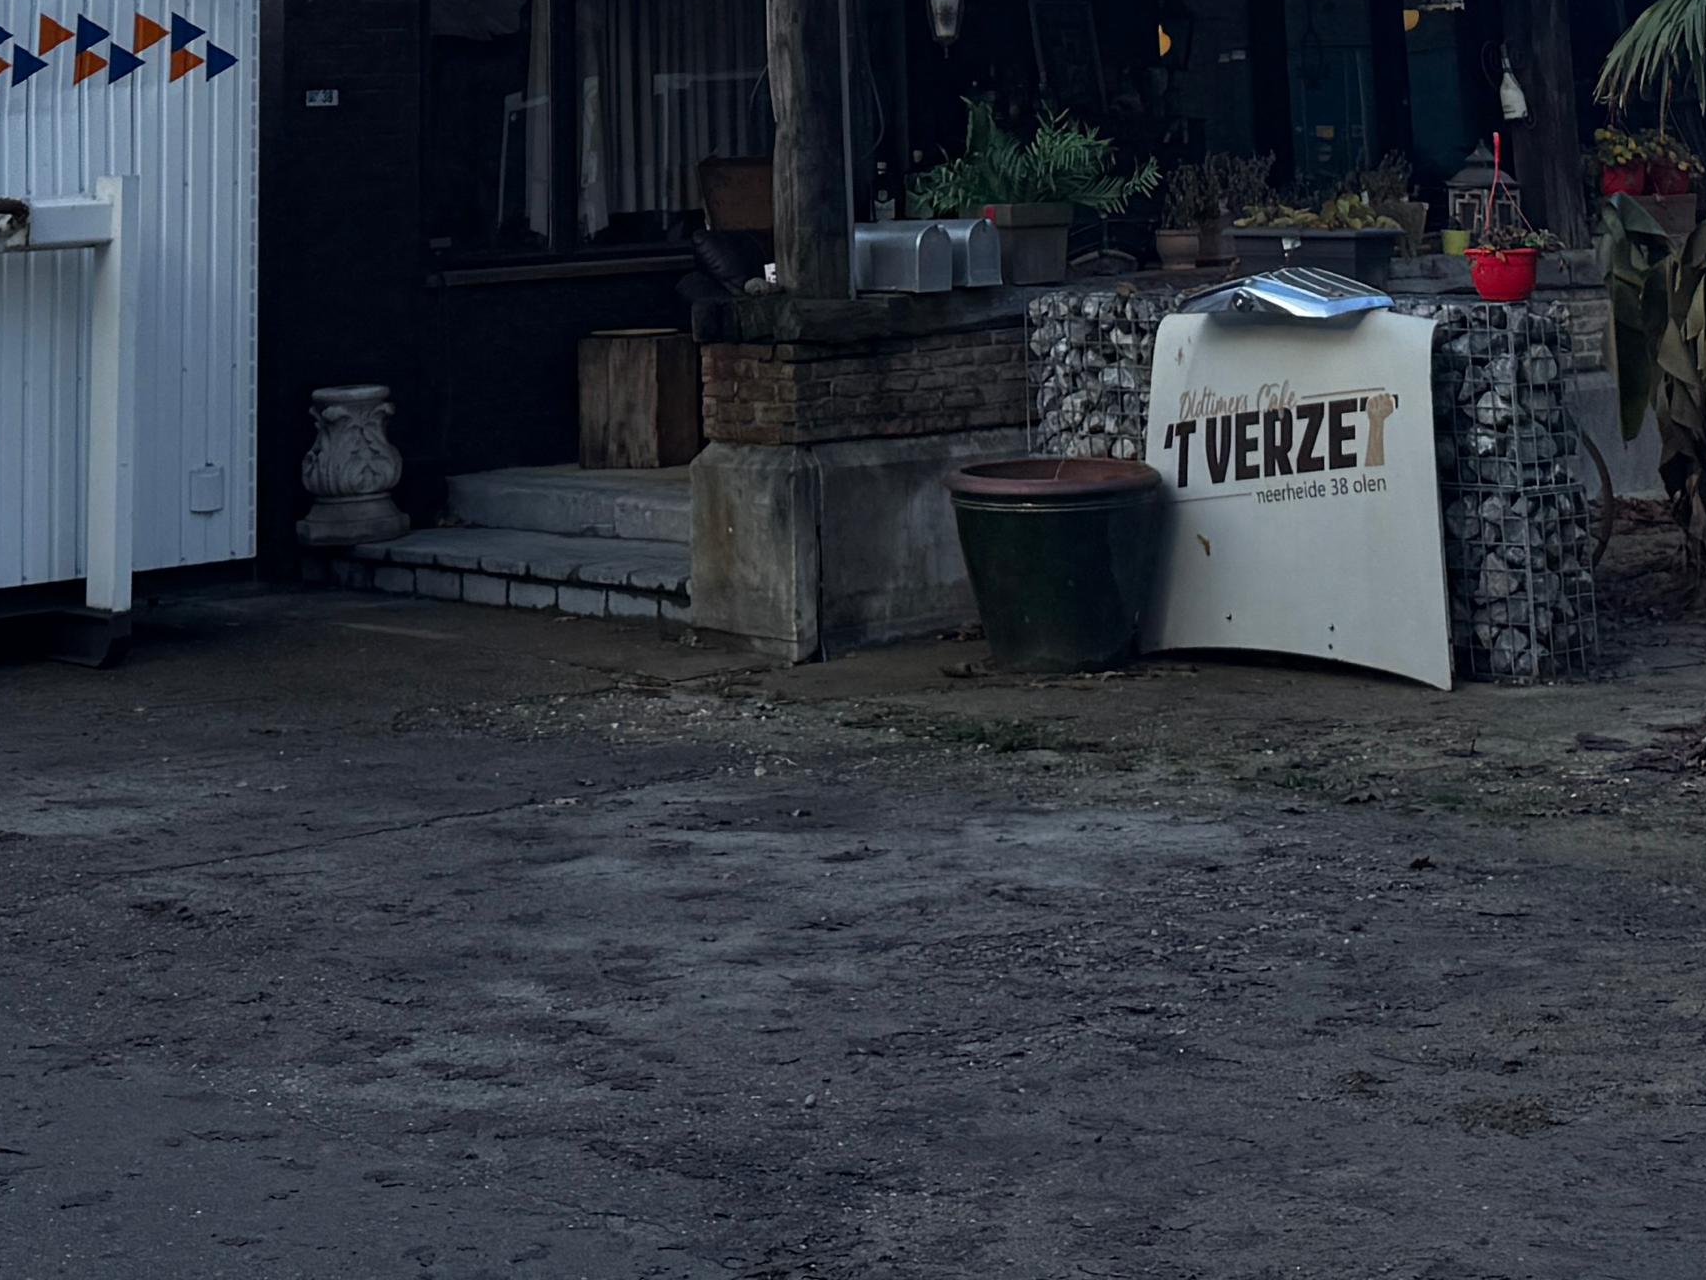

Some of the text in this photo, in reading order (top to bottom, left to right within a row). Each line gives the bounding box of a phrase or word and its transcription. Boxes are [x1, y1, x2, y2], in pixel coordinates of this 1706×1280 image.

[1180, 386, 1248, 422] Oldtimers
[1205, 394, 1399, 484] VERZET
[1256, 473, 1387, 504] neerheide 38 olen
